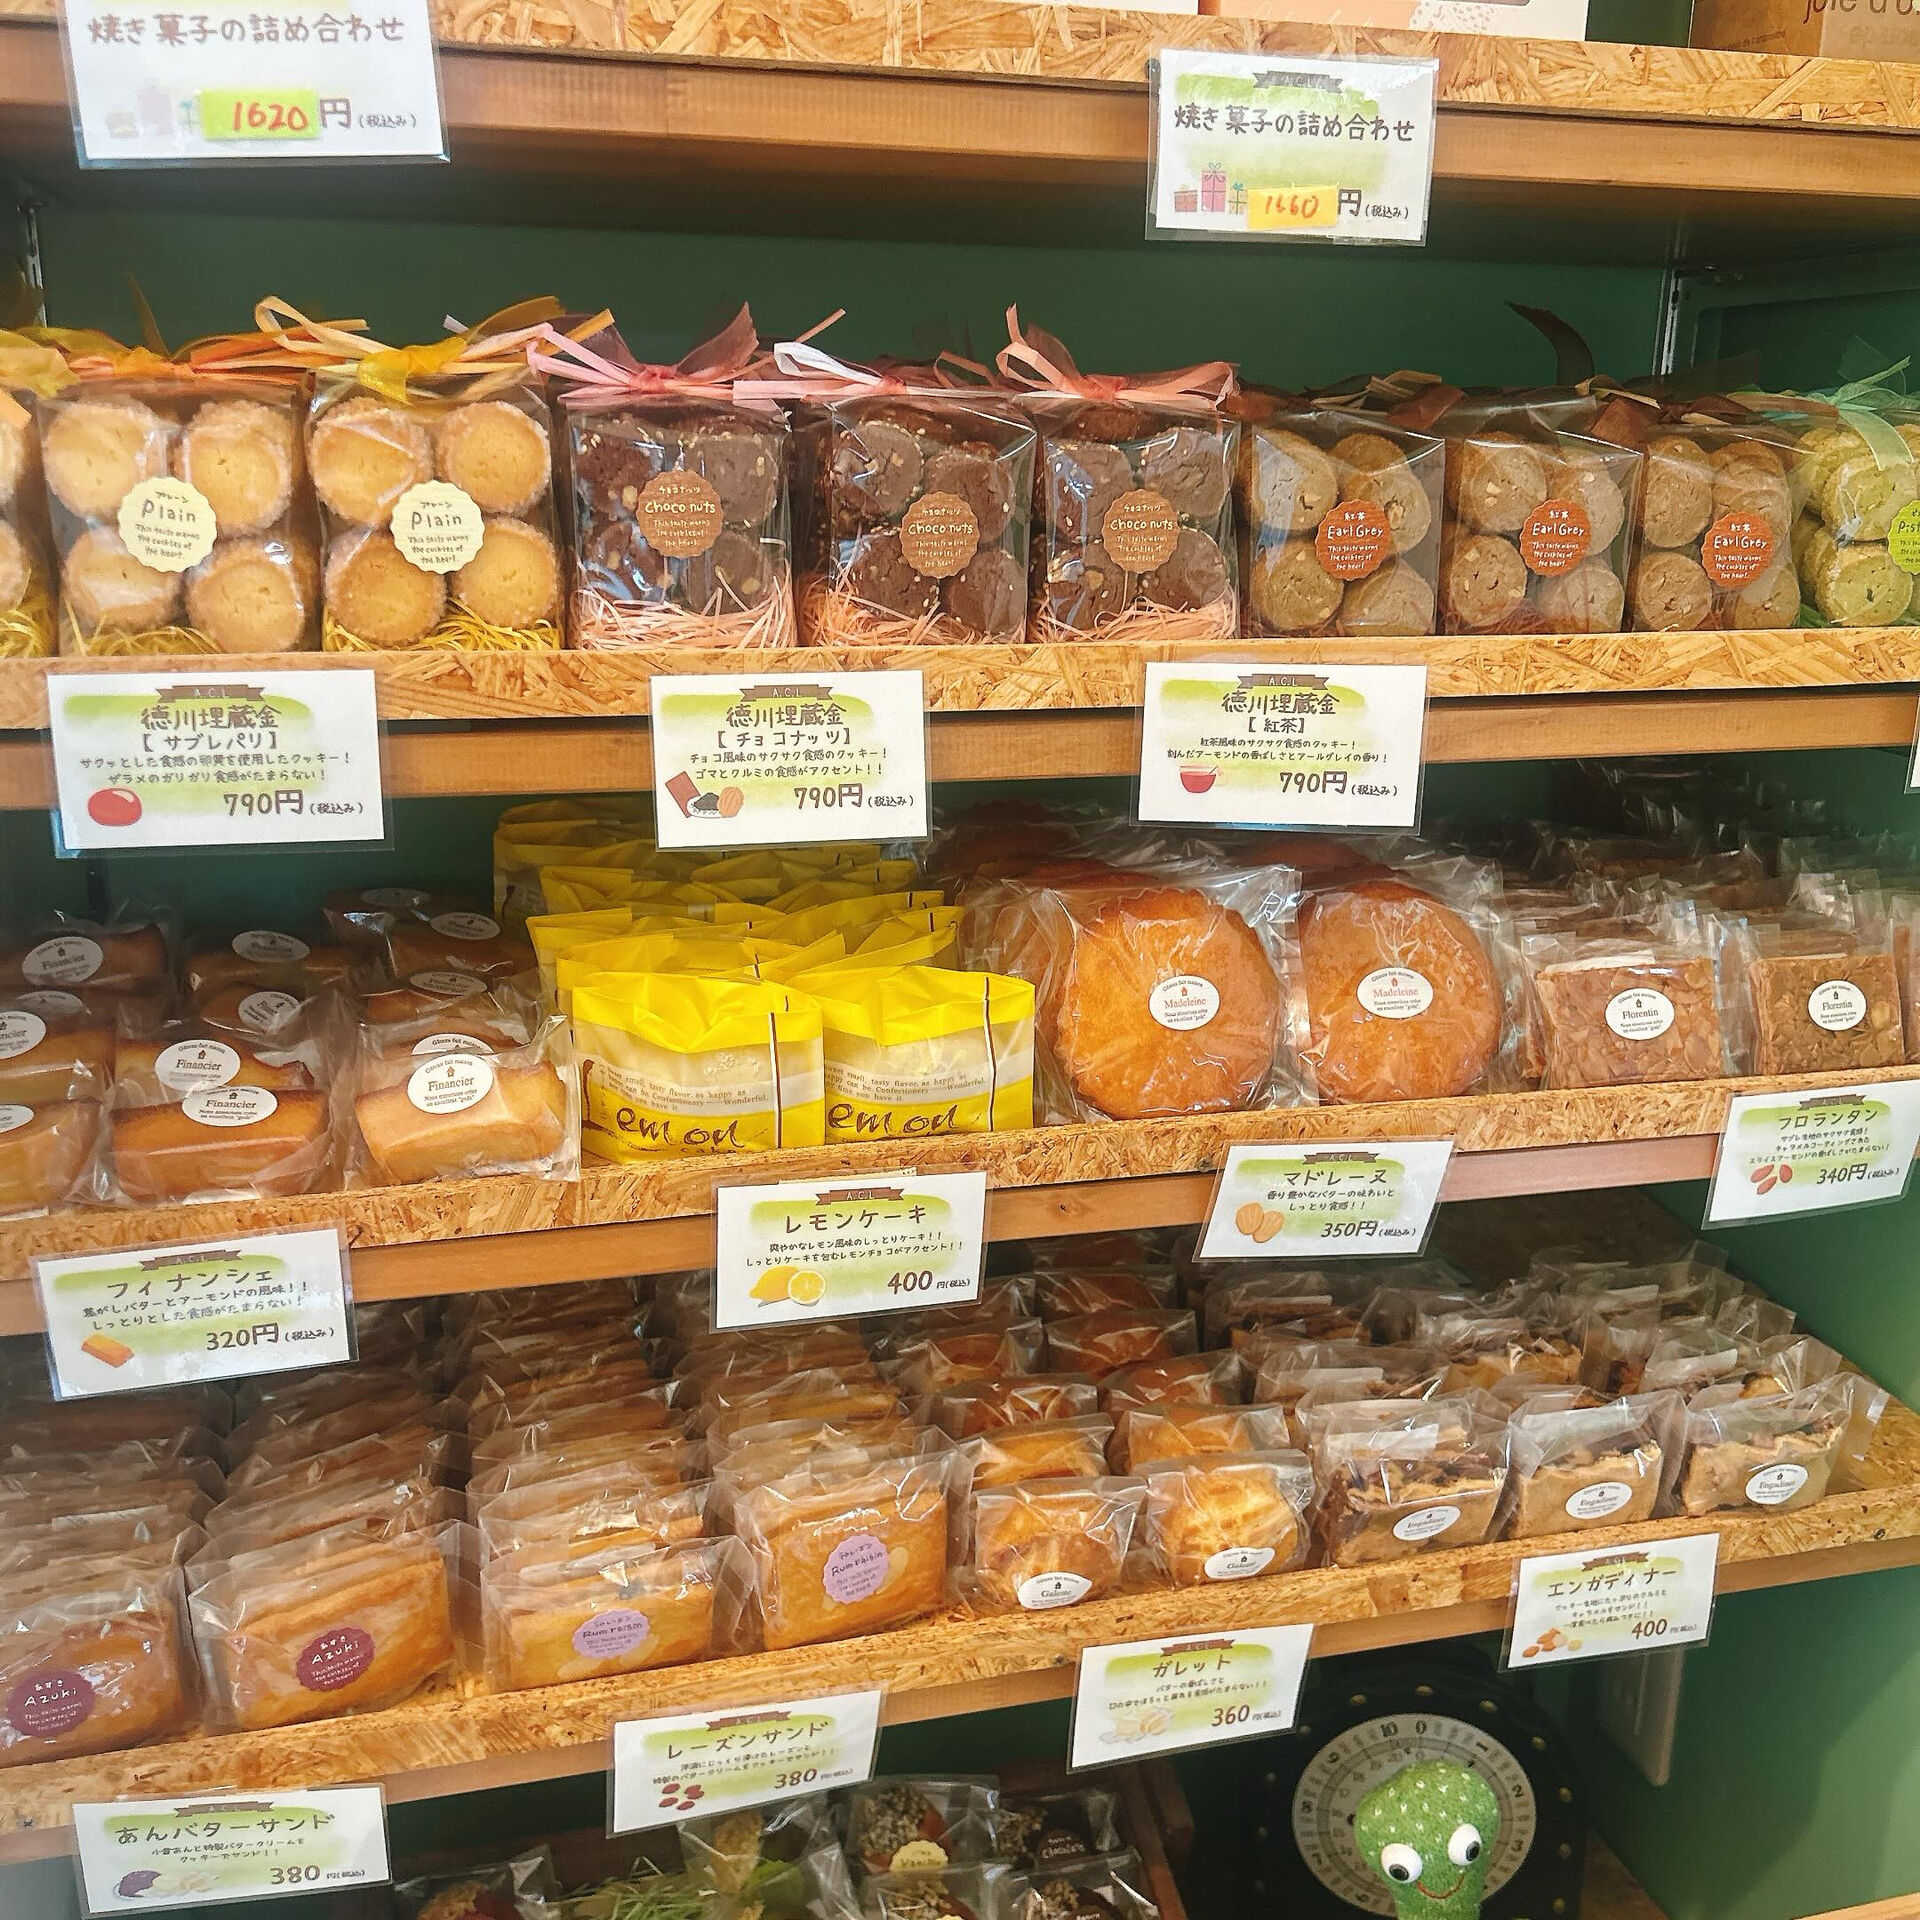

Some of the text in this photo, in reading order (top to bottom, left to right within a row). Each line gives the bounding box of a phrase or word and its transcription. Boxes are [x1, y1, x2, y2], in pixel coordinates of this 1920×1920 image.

[88, 12, 405, 46] 焼き菓子の詰め合わせ
[1174, 103, 1414, 142] 焼き菓子の詰め合わせ
[142, 499, 196, 523] Plain
[690, 500, 716, 513] nuts
[412, 511, 462, 530] Plain
[949, 523, 973, 534] nuts
[1150, 518, 1173, 530] nuts
[1532, 522, 1584, 536] Earl Grey
[1327, 524, 1383, 539] Earl Grey
[1713, 536, 1767, 549] Earl Grey
[1221, 691, 1340, 715] 徳川埋蔵金
[142, 705, 282, 731] 徳川埋蔵金
[726, 703, 847, 728] 徳川埋蔵金
[1164, 996, 1207, 1009] Madeleine
[1373, 987, 1419, 998] Madeleine
[1622, 1008, 1659, 1020] Florentin
[1822, 1000, 1853, 1011] Florentin
[176, 1059, 222, 1071] Financier
[428, 1076, 474, 1092] Financier
[206, 1100, 256, 1110] Financier
[1779, 1109, 1878, 1130] フロランタン
[1284, 1169, 1387, 1186] マドレーヌ
[785, 1205, 926, 1234] レモンケーキ
[108, 1268, 273, 1299] フィナンシェ
[887, 1270, 933, 1295] 400
[1548, 1567, 1676, 1597] エンガディナー
[311, 1641, 358, 1665] Azuki
[1153, 1654, 1230, 1678] ガレット
[24, 1688, 77, 1707] Azuki
[668, 1721, 828, 1759] レーズンサンド
[114, 1813, 335, 1845] あんバターサンド
[269, 1865, 320, 1886] 380
